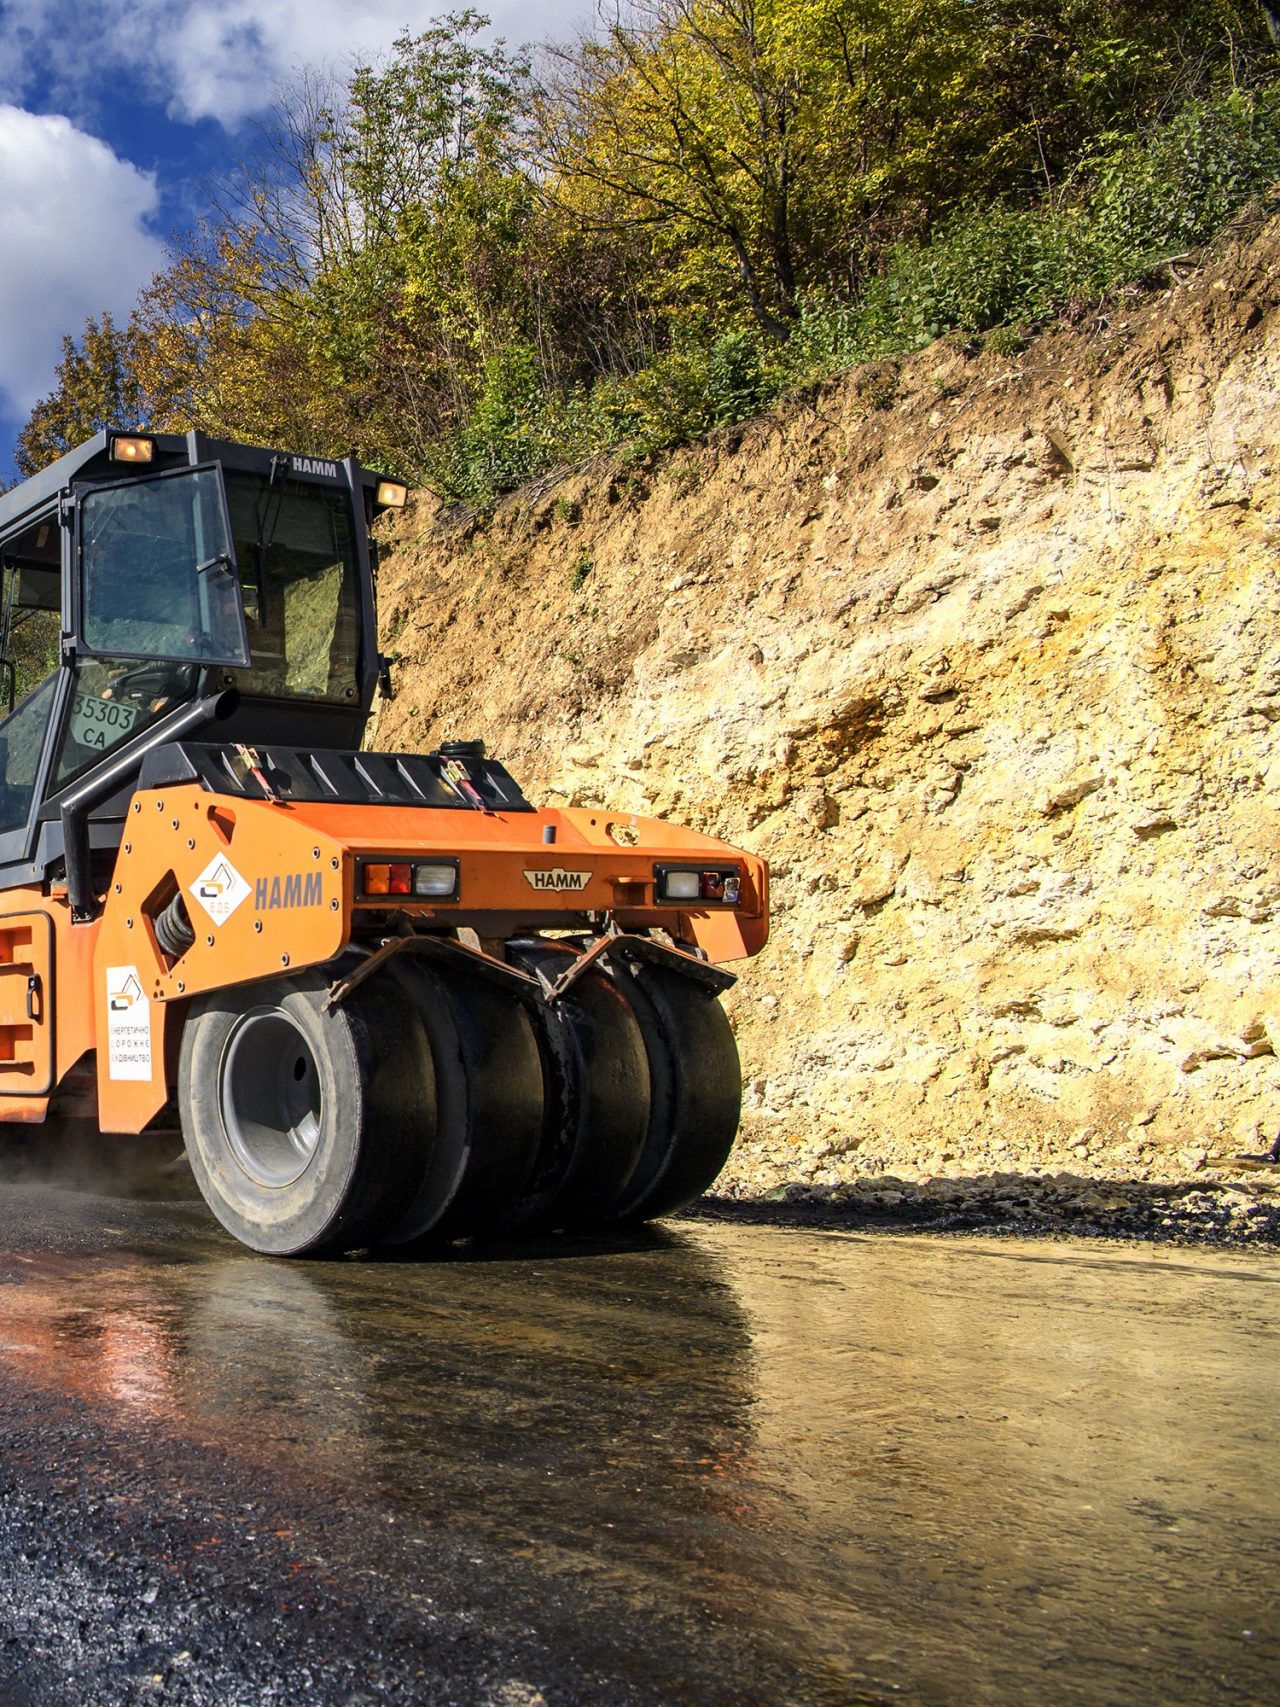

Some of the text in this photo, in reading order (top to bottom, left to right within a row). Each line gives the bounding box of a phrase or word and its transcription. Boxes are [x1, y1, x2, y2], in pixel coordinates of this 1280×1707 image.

[292, 456, 337, 478] HAMM
[72, 694, 134, 730] 35303
[254, 871, 323, 911] HAMM
[534, 873, 582, 888] HAMM
